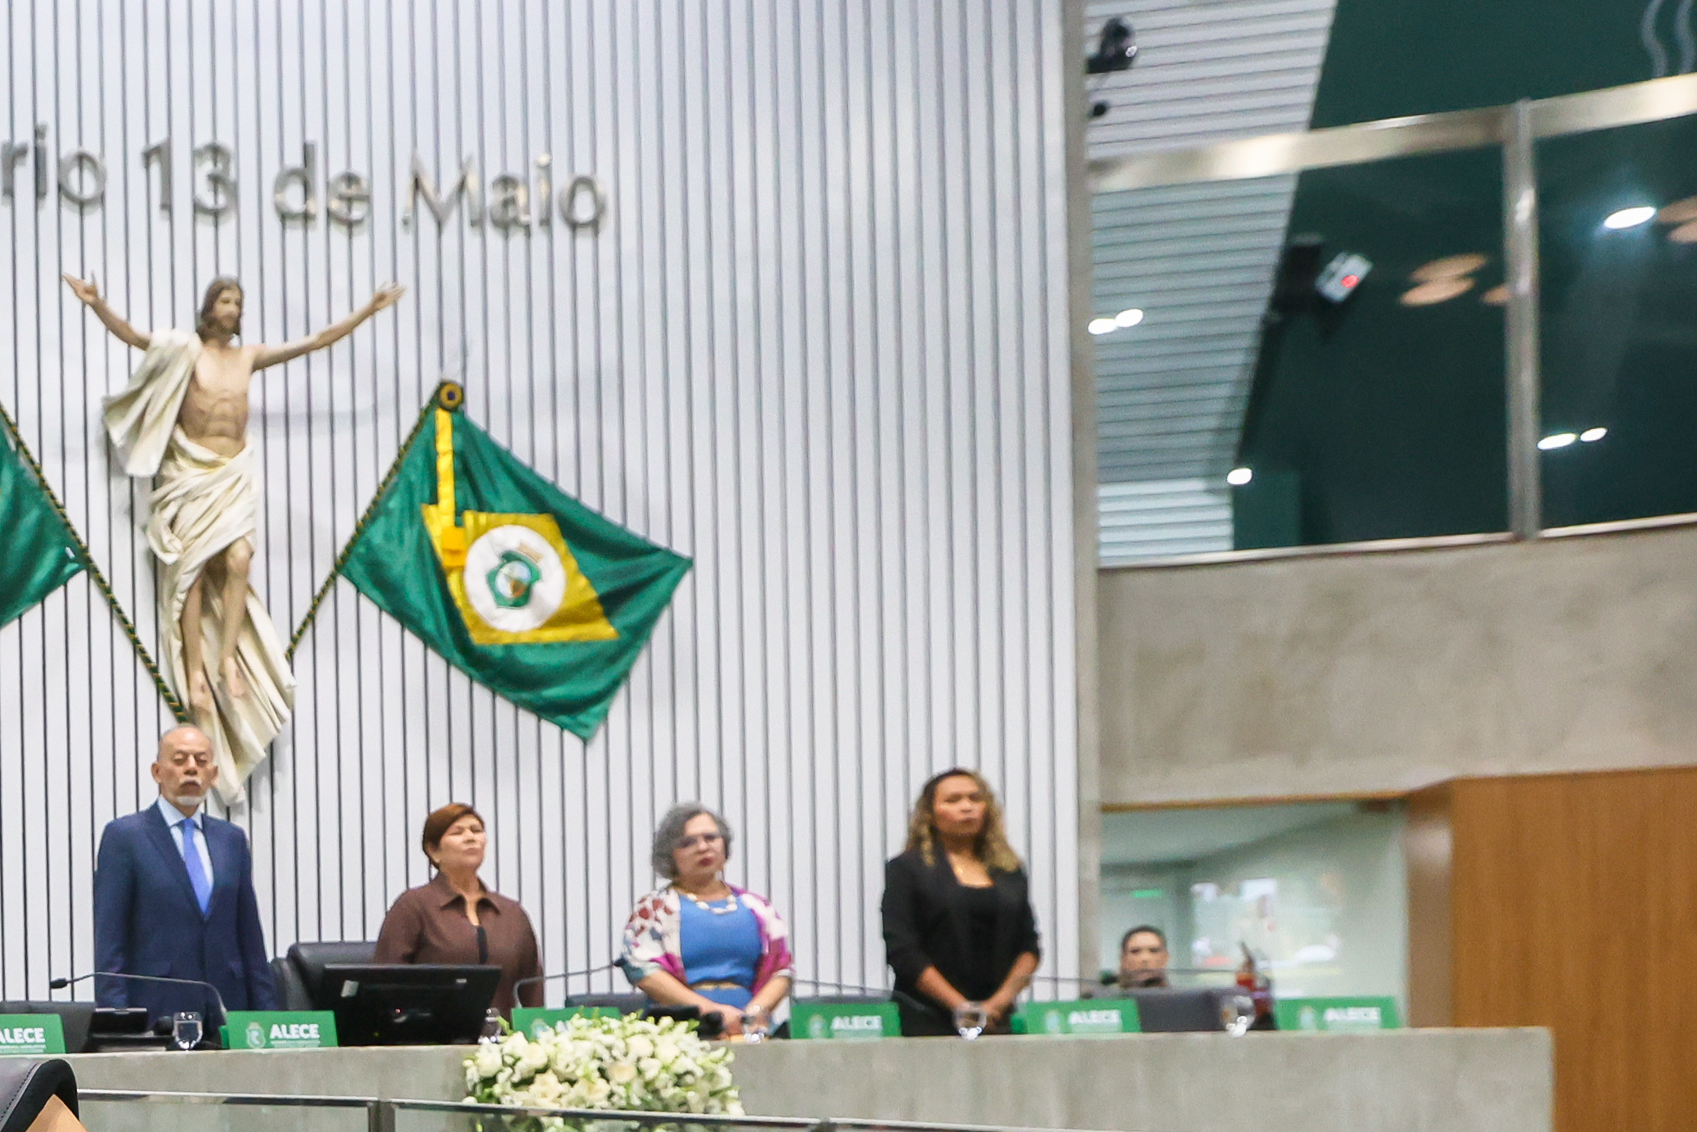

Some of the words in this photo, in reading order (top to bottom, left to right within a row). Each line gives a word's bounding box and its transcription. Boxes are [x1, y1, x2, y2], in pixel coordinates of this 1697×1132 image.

[141, 139, 241, 217] 13
[273, 141, 373, 228] de
[402, 151, 610, 234] Maio
[269, 1023, 320, 1039] ALECE
